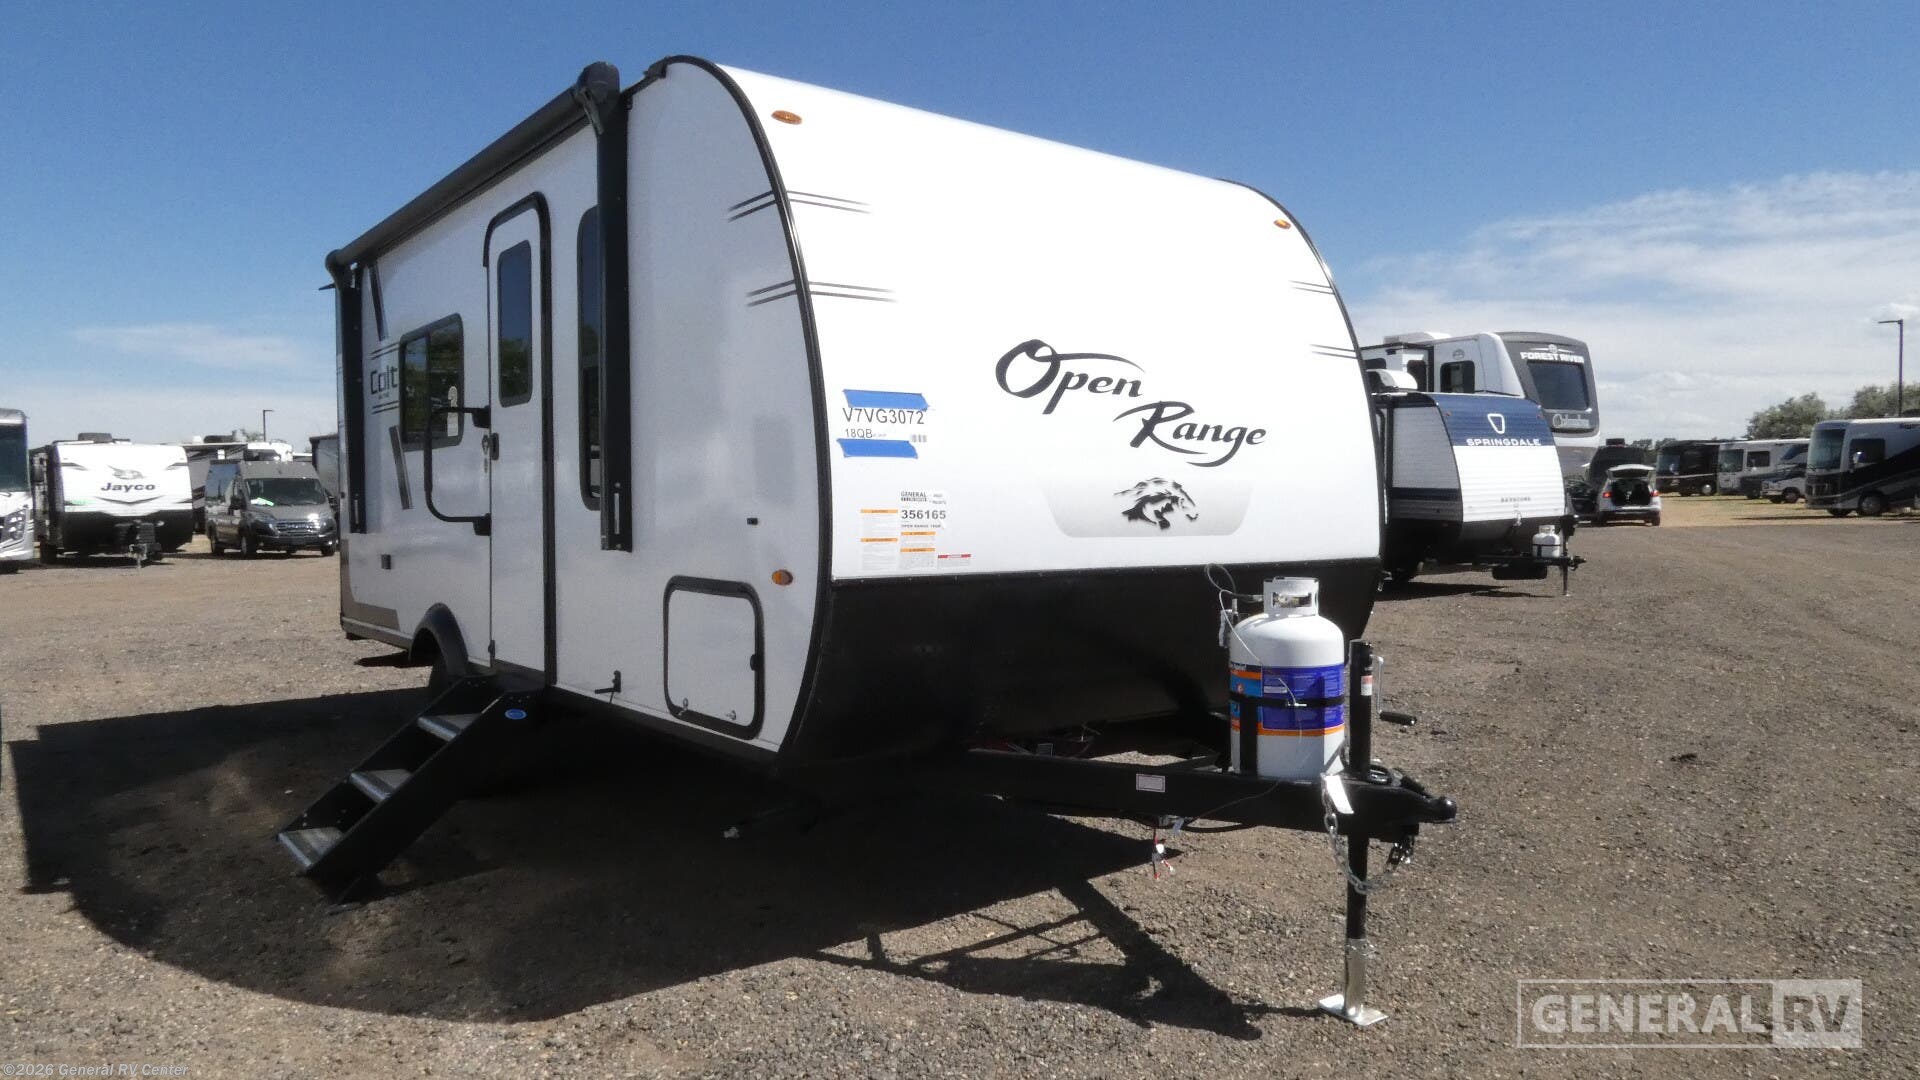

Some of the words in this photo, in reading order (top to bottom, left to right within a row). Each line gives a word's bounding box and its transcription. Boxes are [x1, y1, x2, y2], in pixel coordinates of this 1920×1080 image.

[1520, 352, 1559, 360] FOREST
[1560, 354, 1585, 364] RIVER
[370, 365, 398, 394] Colt
[996, 339, 1145, 415] Open
[842, 407, 925, 424] V7VG3072
[845, 428, 873, 439] 18QB
[1113, 401, 1267, 467] Range
[1466, 438, 1541, 446] SPRINGDALE
[100, 482, 156, 493] Jayco
[901, 509, 946, 520] 356165
